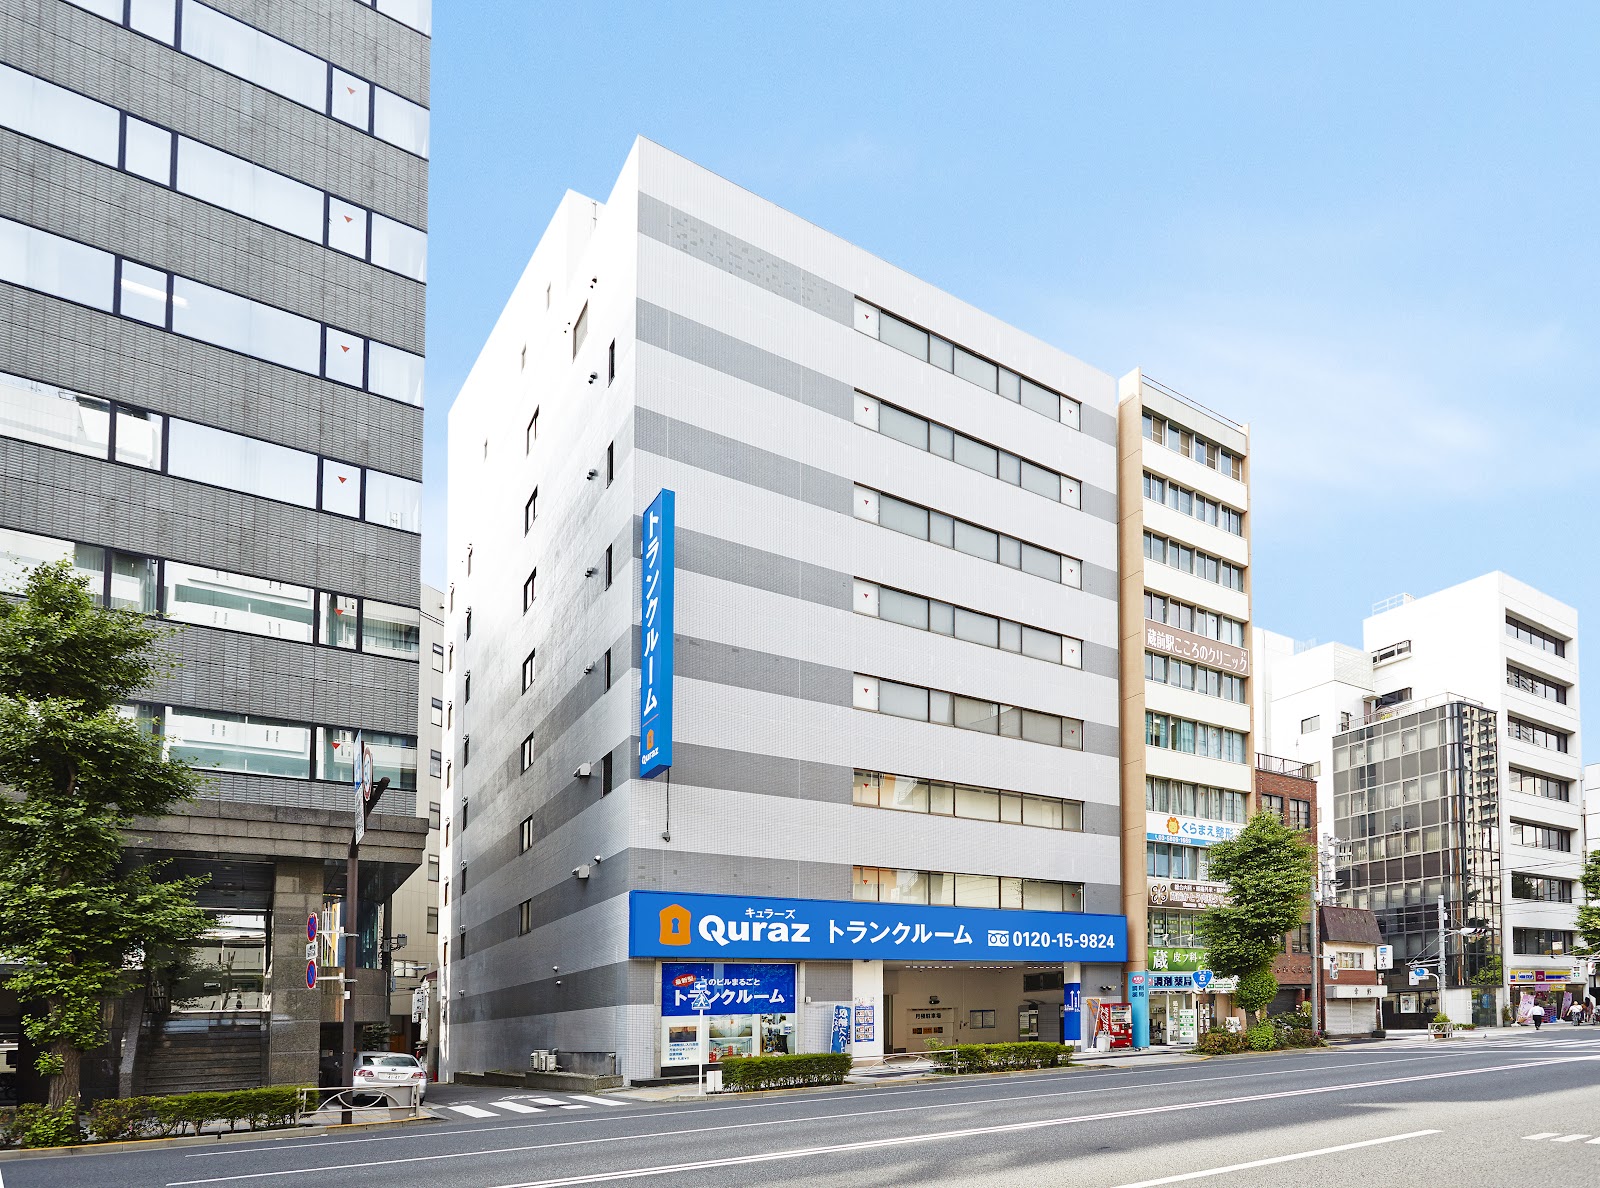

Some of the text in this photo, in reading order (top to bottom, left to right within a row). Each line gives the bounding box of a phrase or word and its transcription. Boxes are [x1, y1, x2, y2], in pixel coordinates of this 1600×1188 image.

[644, 510, 659, 717] トランクルーム
[1147, 628, 1247, 672] 蔵前駅こころのクリニック
[641, 747, 659, 765] Quraz
[745, 908, 796, 919] キュラーズ
[698, 914, 811, 947] Quraz
[829, 919, 1115, 949] トランクルーム 0120-15-9824
[1152, 949, 1169, 970] 蔵
[1154, 976, 1192, 987] 調剤薬局
[1199, 974, 1206, 982] 6
